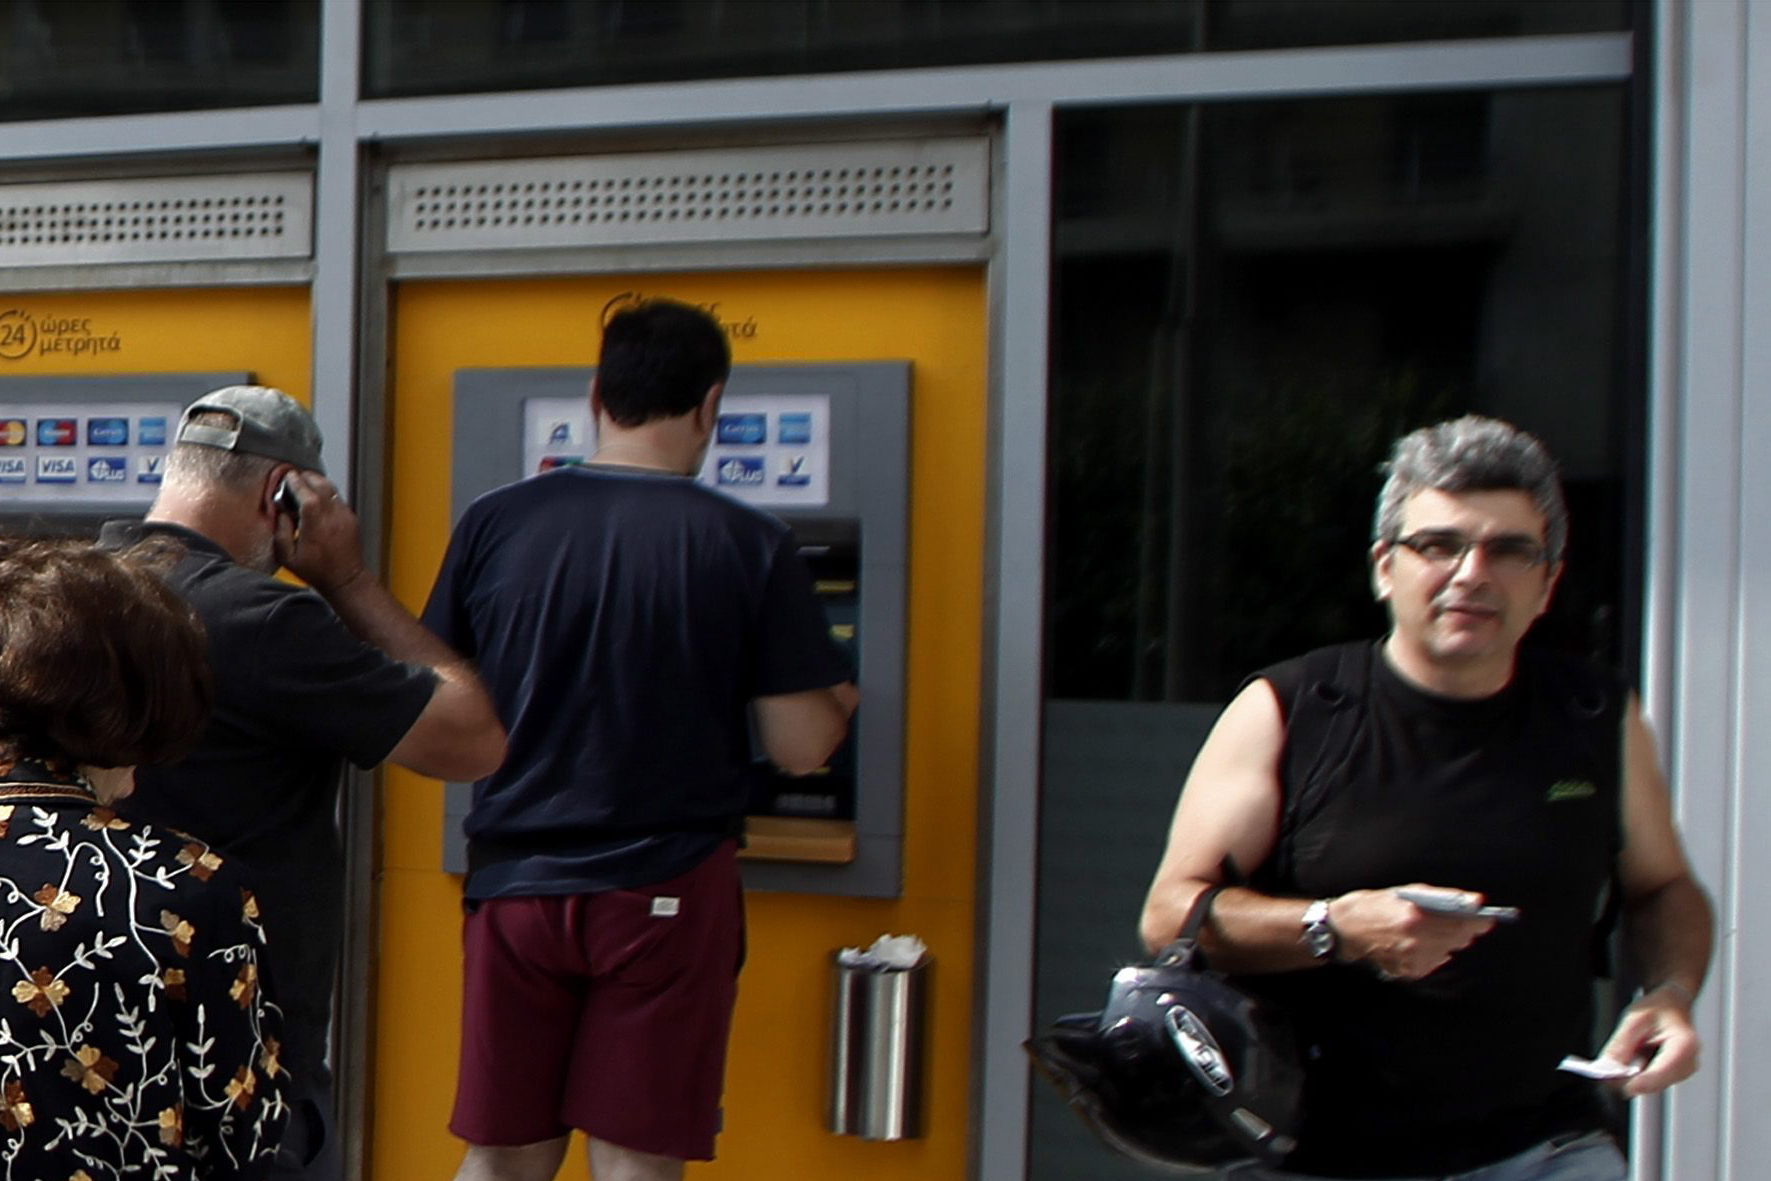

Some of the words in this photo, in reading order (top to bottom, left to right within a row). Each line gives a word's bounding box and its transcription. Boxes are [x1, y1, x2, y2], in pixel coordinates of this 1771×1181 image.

[0, 323, 26, 346] 24
[40, 314, 92, 336] ώρες
[40, 330, 121, 356] μετρητά
[42, 460, 75, 473] VISA
[100, 467, 125, 480] PLUS
